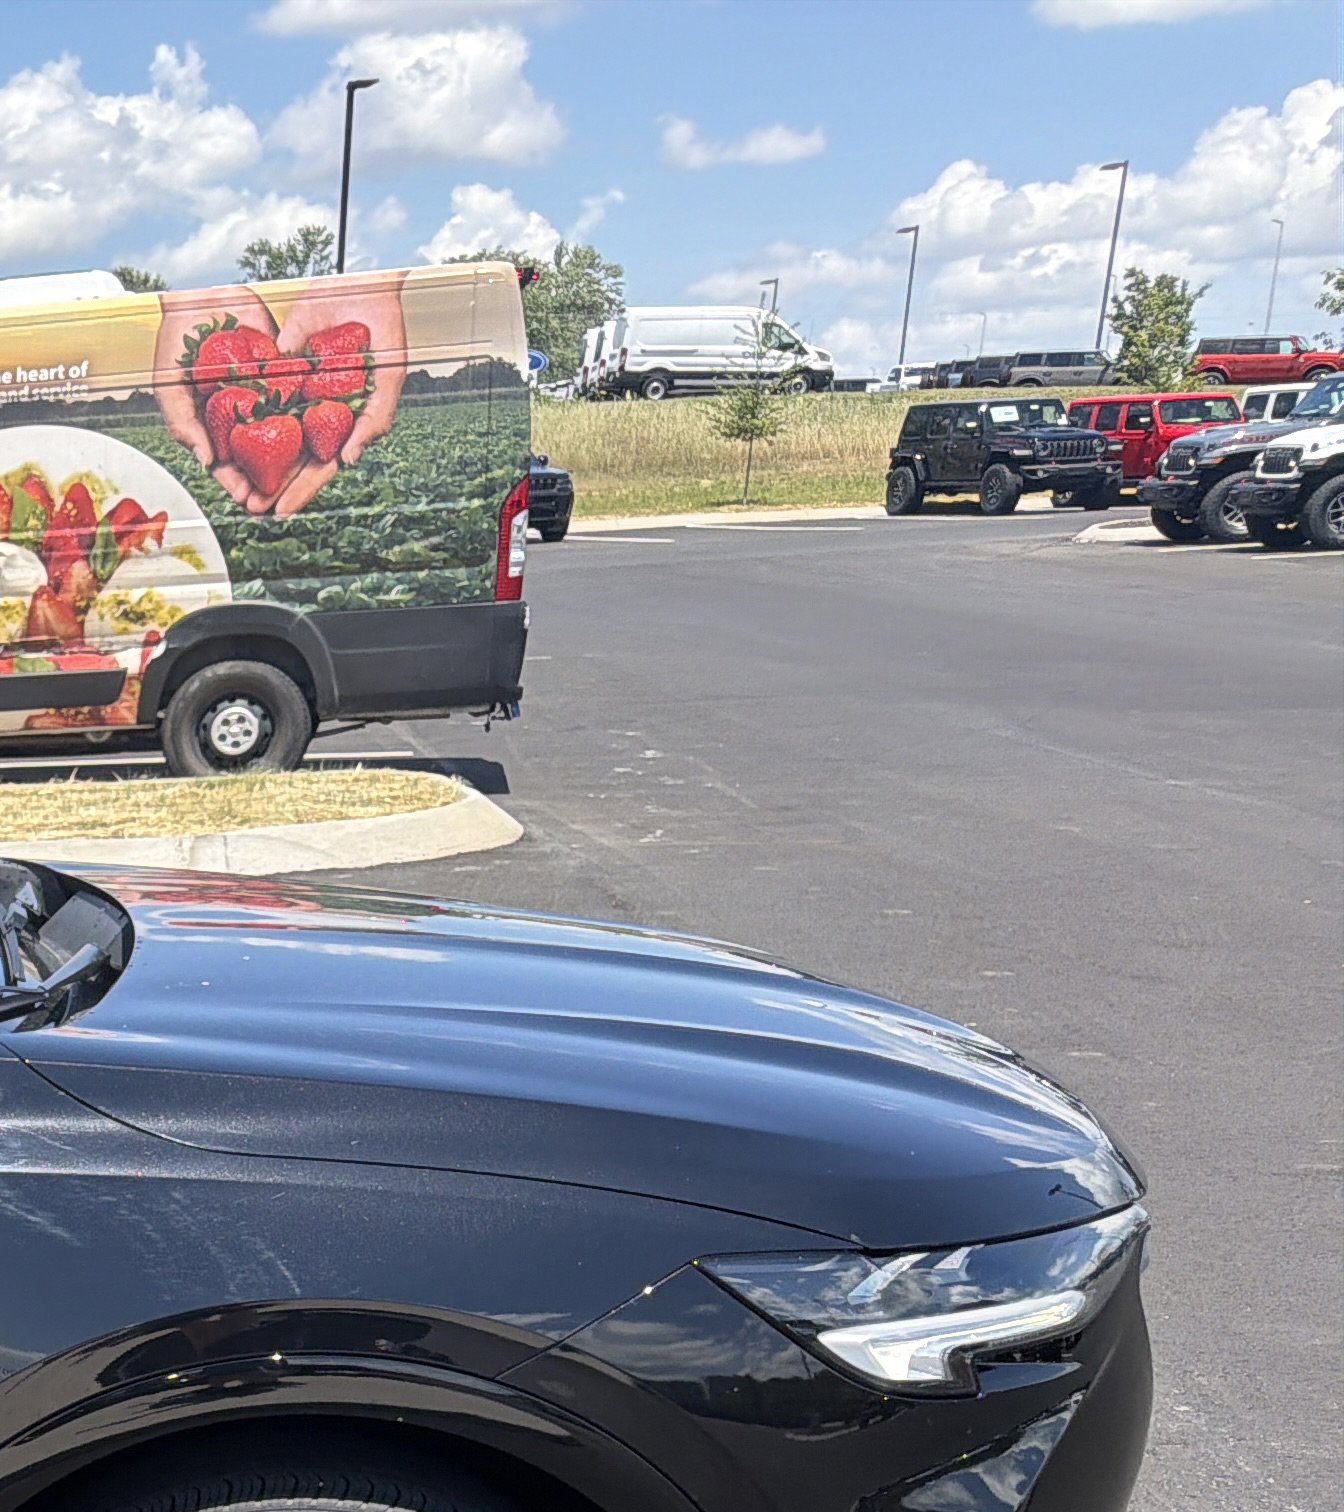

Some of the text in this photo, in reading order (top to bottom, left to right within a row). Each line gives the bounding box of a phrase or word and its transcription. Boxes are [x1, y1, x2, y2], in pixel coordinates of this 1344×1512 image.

[16, 364, 65, 383] heart
[68, 359, 89, 379] of
[31, 381, 89, 402] service
